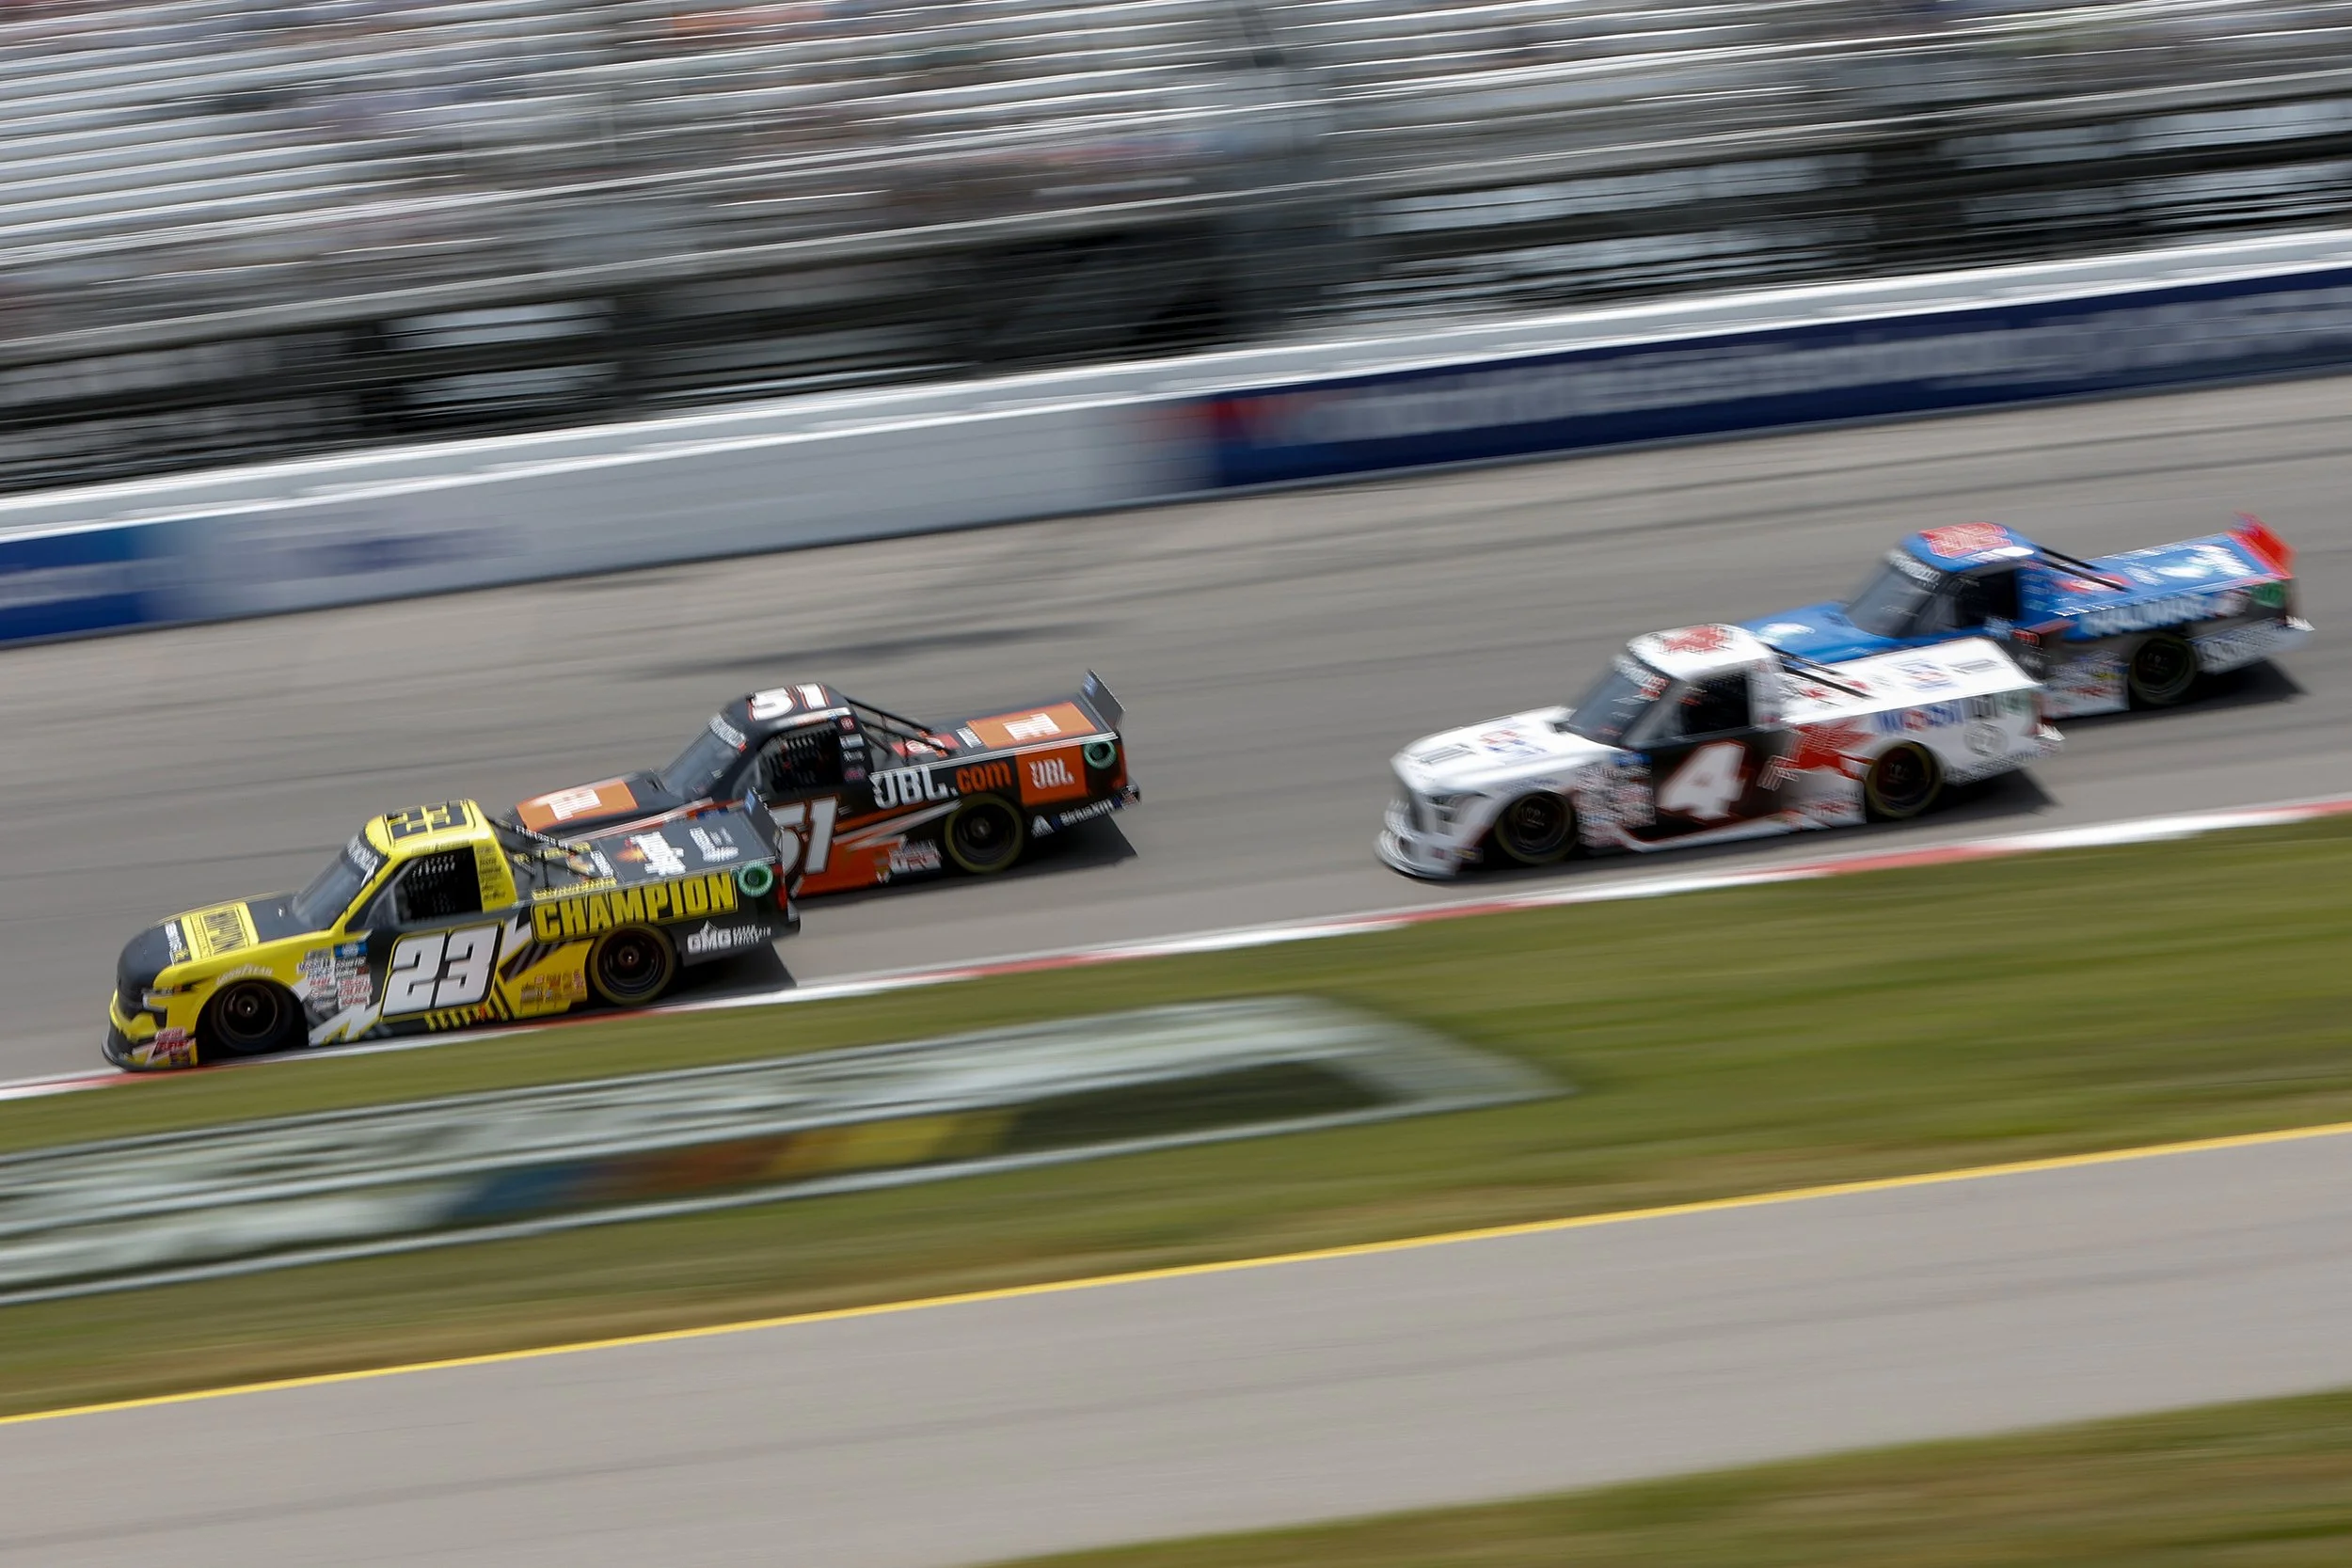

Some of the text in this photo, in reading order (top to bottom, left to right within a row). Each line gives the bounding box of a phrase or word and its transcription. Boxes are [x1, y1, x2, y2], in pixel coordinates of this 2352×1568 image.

[868, 762, 1013, 810] JBL.com
[1028, 756, 1076, 790] JBL
[1656, 737, 1746, 822] 4
[769, 795, 836, 875] 51
[530, 871, 738, 941] CHAMPION
[381, 923, 500, 1018] 23
